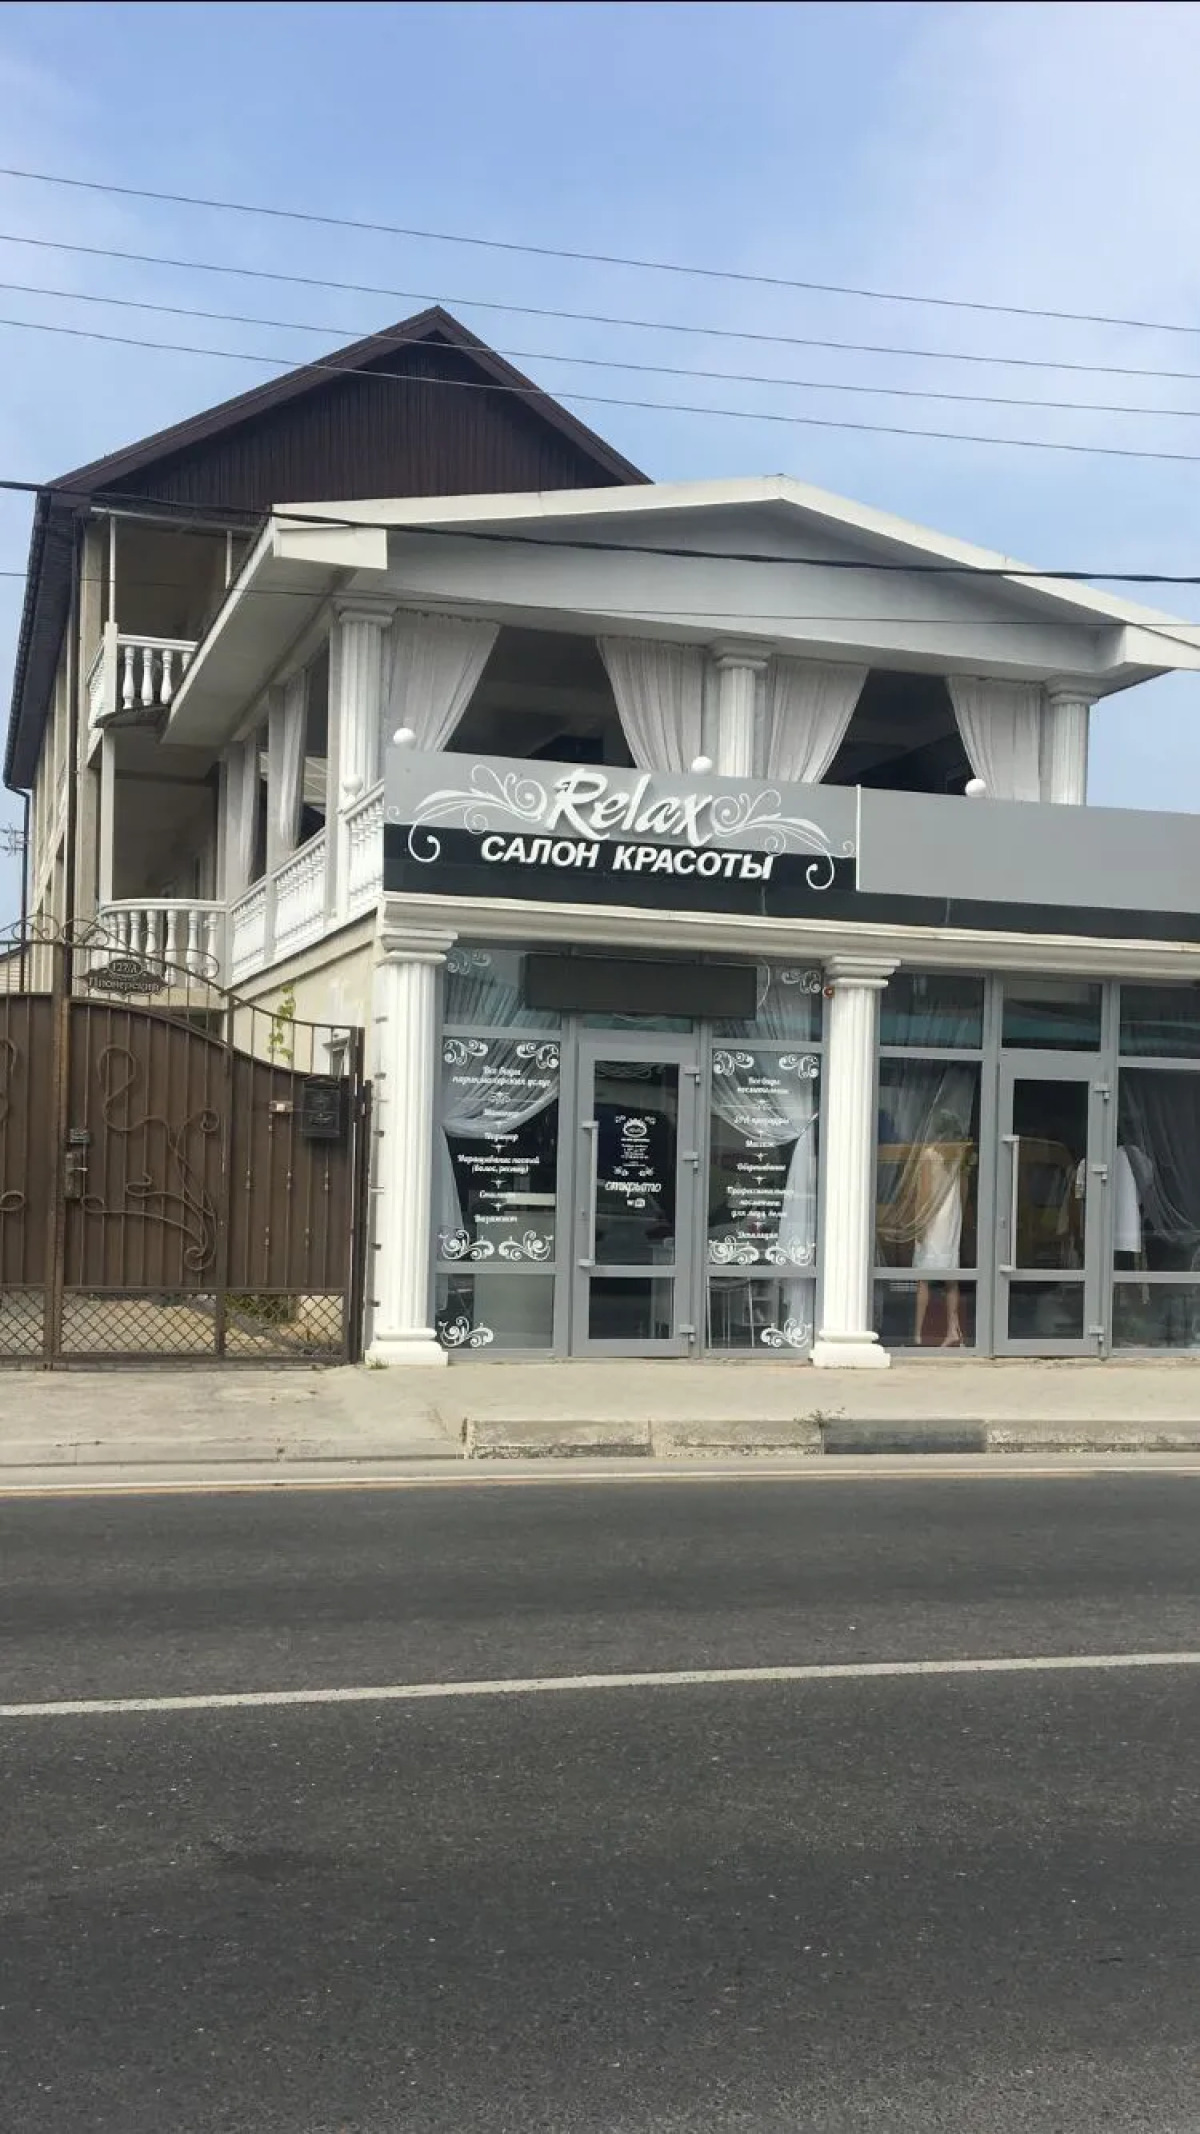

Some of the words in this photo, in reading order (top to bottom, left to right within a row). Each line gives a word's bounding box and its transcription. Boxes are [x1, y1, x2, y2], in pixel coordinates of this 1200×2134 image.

[544, 767, 714, 847] Relax
[480, 835, 598, 869] САЛОН
[613, 845, 774, 881] КРАСОТЫ
